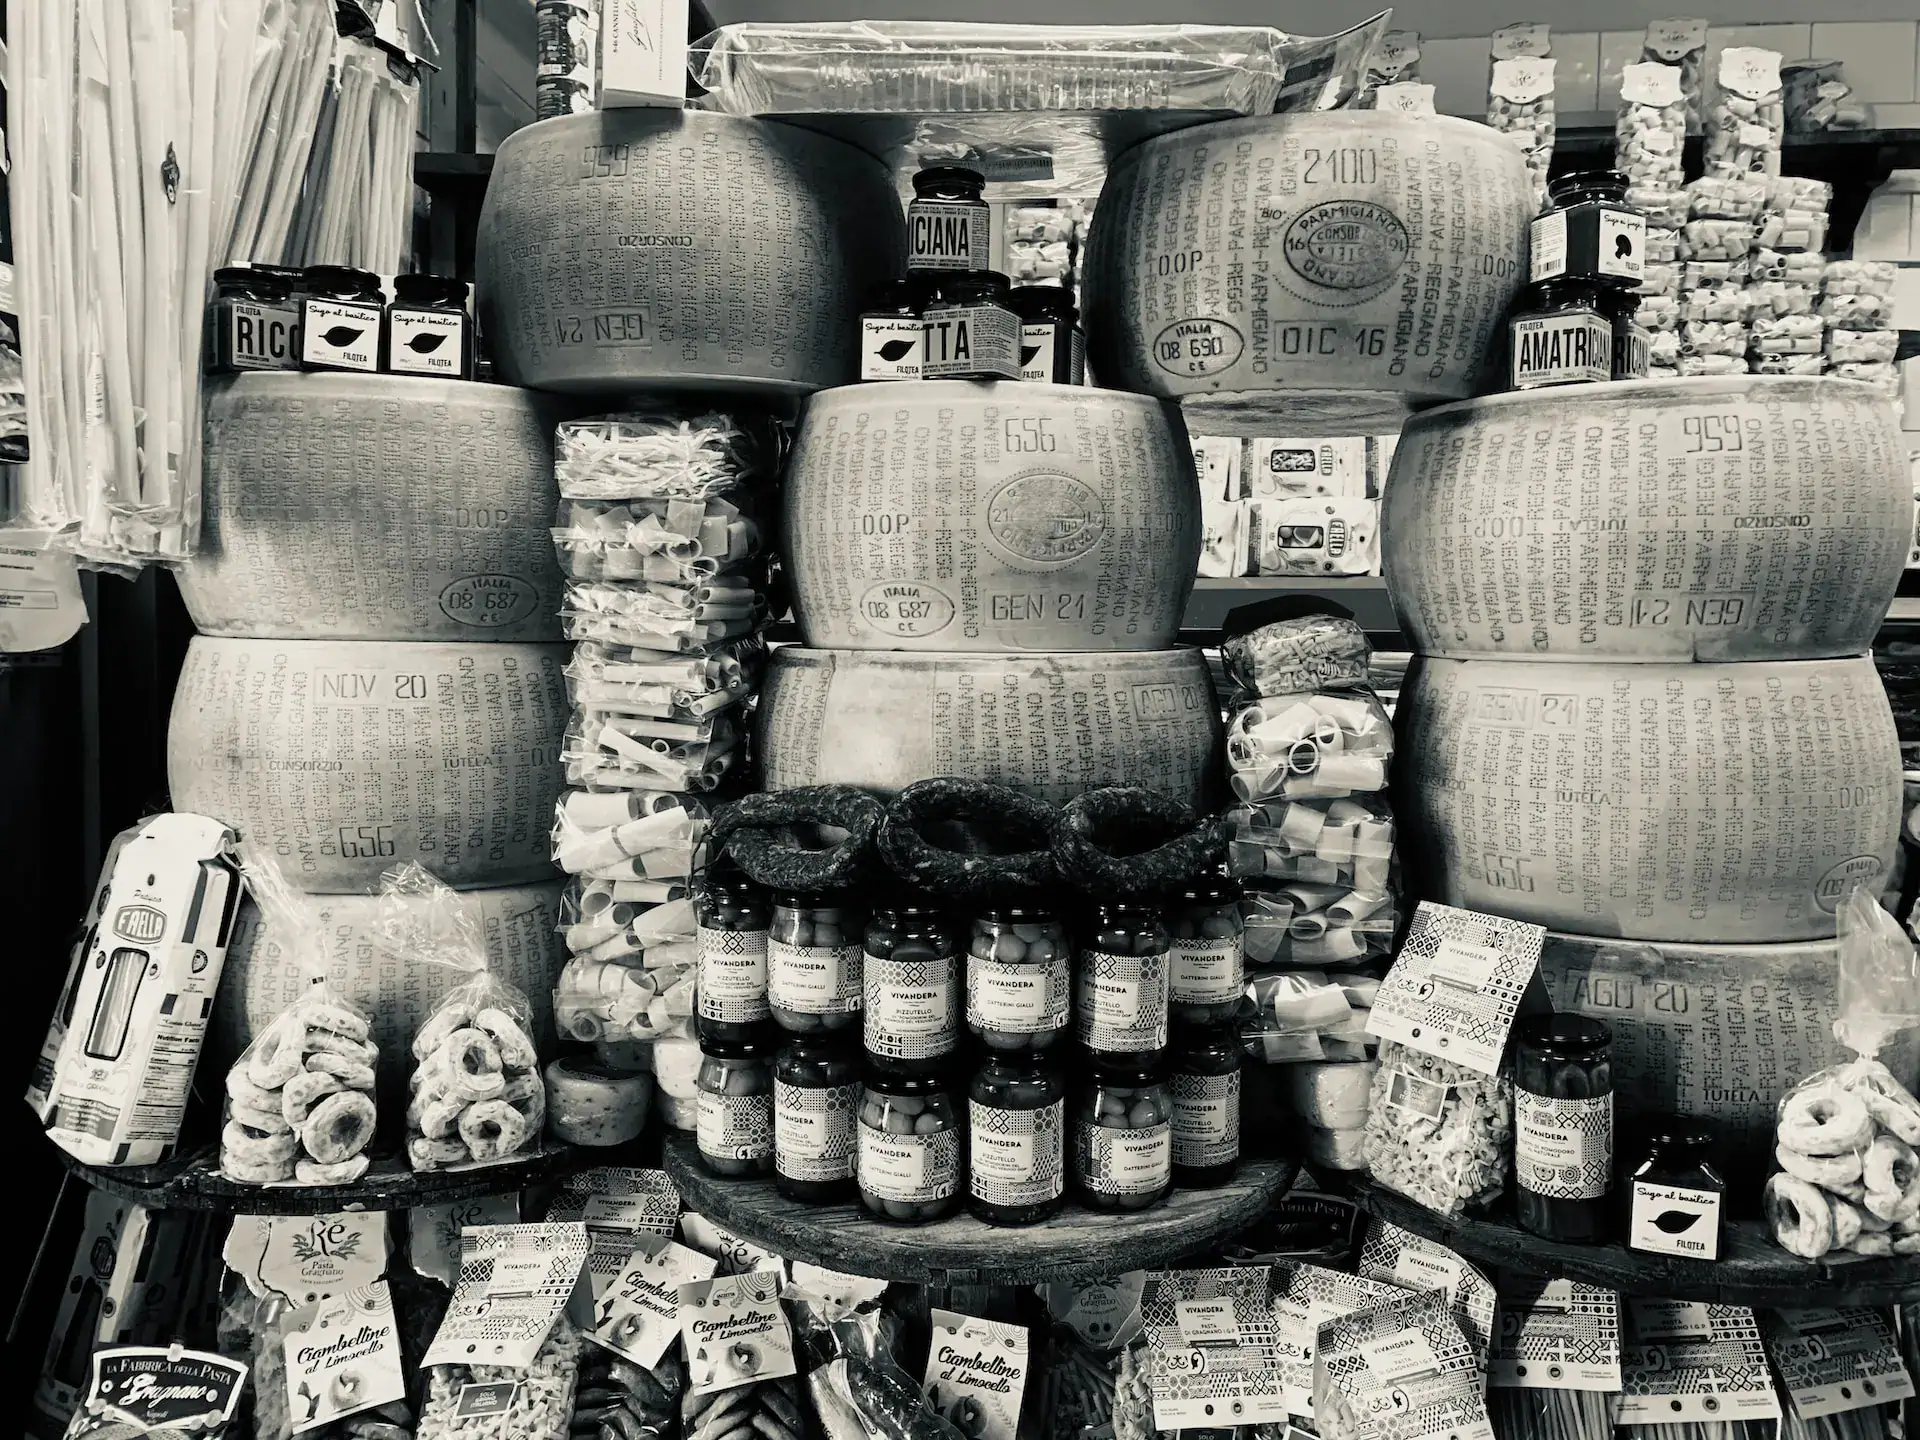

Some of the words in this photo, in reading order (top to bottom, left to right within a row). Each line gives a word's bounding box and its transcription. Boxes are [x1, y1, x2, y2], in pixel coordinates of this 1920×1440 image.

[1304, 148, 1377, 184] 2100
[1300, 205, 1398, 234] PARMIGIANO
[618, 233, 692, 249] CONSORZIO
[1288, 236, 1306, 252] 16
[236, 306, 261, 316] FILOTEA
[309, 305, 330, 318] Sugo
[333, 308, 342, 317] al
[345, 310, 376, 322] basilico
[394, 314, 415, 326] Sugo
[417, 316, 426, 324] al
[428, 317, 459, 327] basilico
[1520, 321, 1544, 331] FILOTEA
[557, 315, 584, 346] 21
[594, 313, 644, 343] GEN
[865, 322, 885, 334] Sugo
[886, 323, 895, 331] al
[1175, 323, 1211, 336] ITALIA
[1281, 327, 1335, 356] DIC
[1354, 326, 1386, 357] 16
[342, 351, 368, 363] FILOTEA
[1162, 340, 1184, 360] 08
[428, 358, 452, 368] FILOTEA
[896, 365, 919, 375] FILOTEA
[1734, 515, 1811, 530] CONSORZIO
[472, 578, 512, 591] ITALIA
[449, 590, 472, 609] 08
[485, 591, 520, 609] 687
[883, 586, 921, 599] ITALIA
[868, 600, 889, 619] 08
[898, 600, 932, 619] 687
[991, 593, 1044, 621] GEN
[1058, 592, 1086, 620] 21
[1637, 600, 1670, 626] 21
[1685, 599, 1744, 626] GEN
[322, 673, 377, 698] NOV
[395, 673, 428, 699] 20
[1543, 696, 1573, 725] 21
[269, 760, 343, 772] CONSORZIO
[443, 756, 494, 768] TUTELA
[1555, 790, 1611, 806] TUTELA
[117, 909, 163, 938] FAELLA
[1180, 954, 1226, 962] VIVANDERA
[1448, 946, 1487, 962] VIVANDERA
[712, 959, 756, 967] VIVANDERA
[783, 960, 827, 970] VIVANDERA
[987, 978, 1035, 988] VIVANDERA
[1084, 980, 1128, 994] VIVANDERA
[890, 991, 938, 1000] VIVANDERA
[1573, 979, 1634, 1010] AGO
[1654, 983, 1689, 1014] 20
[1703, 1088, 1759, 1103] TUTELA
[1174, 1102, 1218, 1112] VIVANDERA
[978, 1134, 1022, 1148] VIVANDERA
[1523, 1126, 1569, 1142] VIVANDERA
[869, 1145, 912, 1159] VIVANDERA
[1124, 1140, 1164, 1153] VIVANDERA
[597, 1199, 637, 1207] VIVANDERA
[1637, 1187, 1663, 1201] Sugo
[1665, 1190, 1676, 1199] al
[1678, 1192, 1716, 1206] basilico
[1676, 1239, 1706, 1251] FILOTEA
[312, 1260, 334, 1270] Pasta
[1409, 1256, 1450, 1275] VIVANDERA
[1416, 1276, 1435, 1286] PASTA
[620, 1288, 635, 1299] al
[1185, 1306, 1225, 1314] VIVANDERA
[692, 1310, 778, 1334] Ciambelline
[701, 1332, 713, 1343] al
[1192, 1328, 1221, 1336] GRAGNANO
[297, 1323, 391, 1365] Ciambelline
[1373, 1338, 1415, 1355] VIVANDERA
[305, 1360, 319, 1375] al
[938, 1345, 1022, 1381] Ciambelline
[106, 1364, 118, 1374] LA
[120, 1358, 173, 1374] FABBRICA
[173, 1365, 199, 1377] DELLA
[199, 1363, 233, 1386] PASTA
[940, 1366, 953, 1380] al
